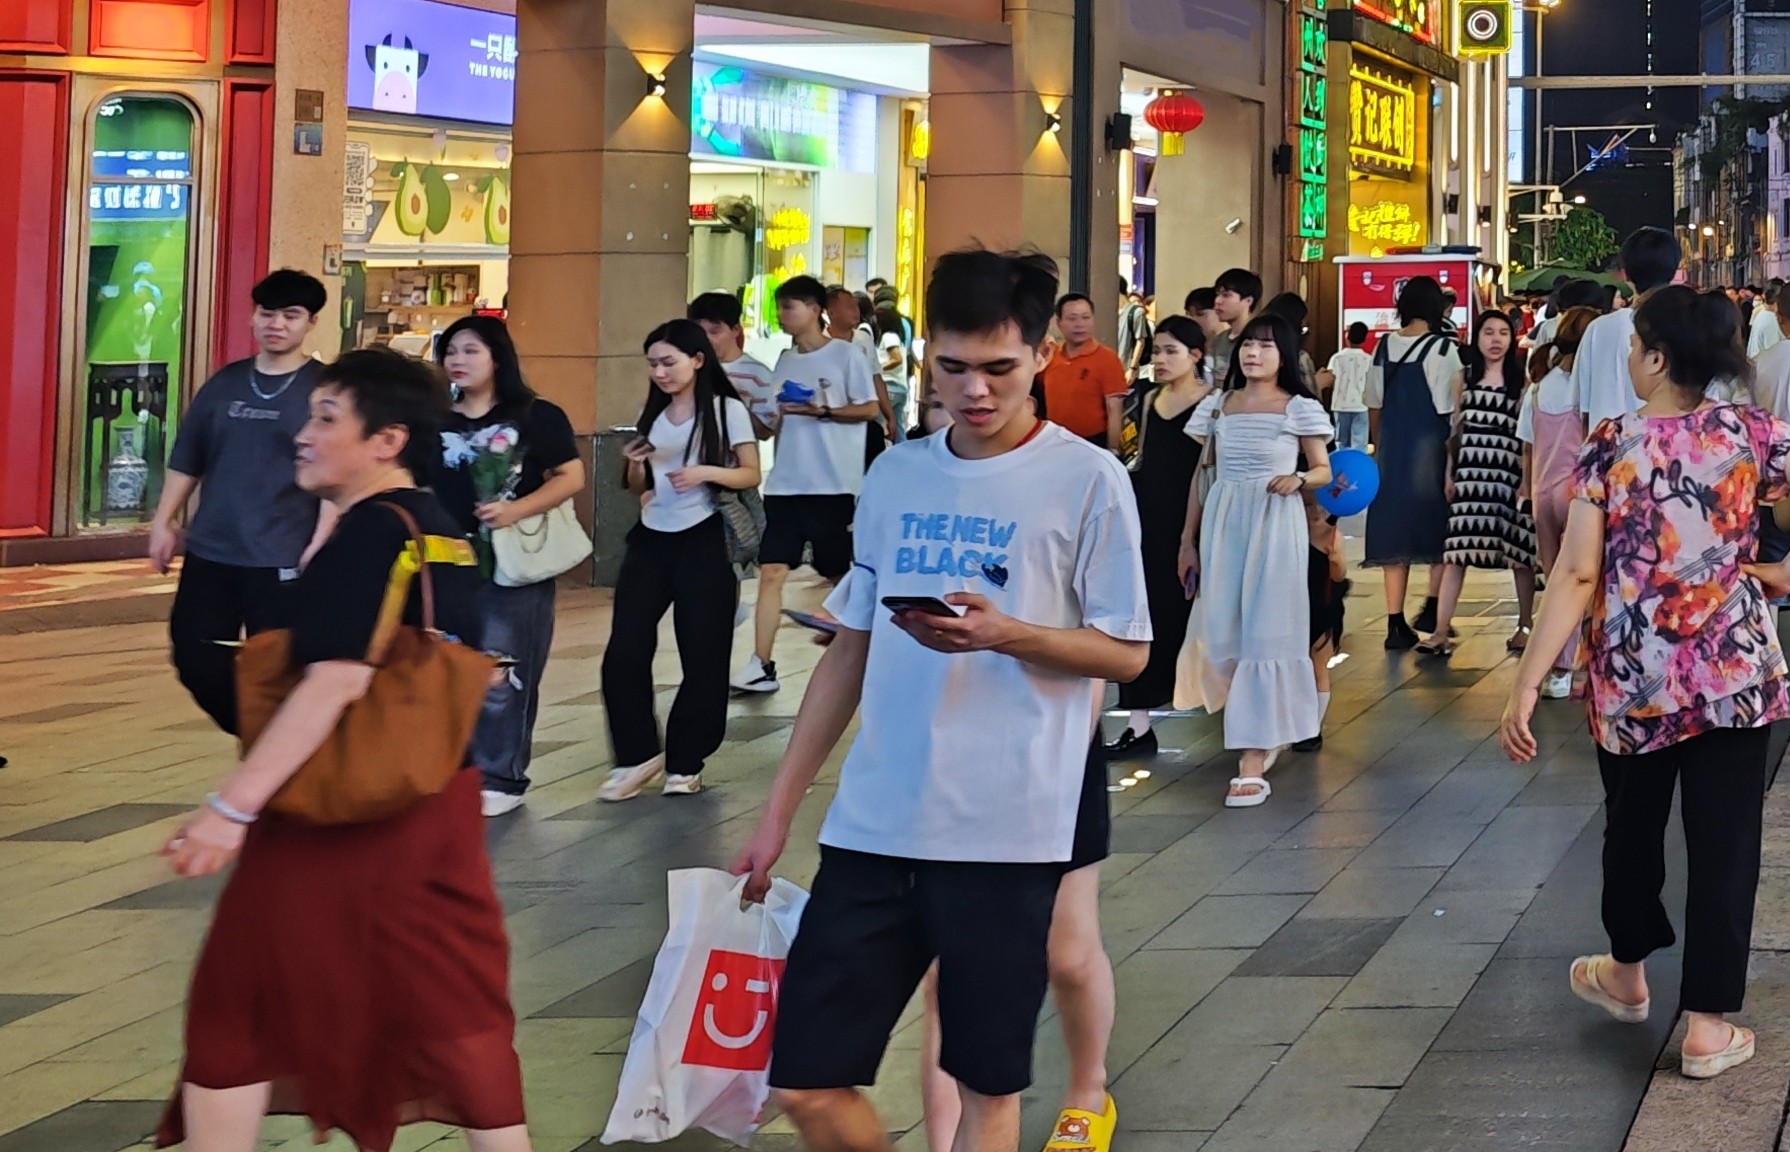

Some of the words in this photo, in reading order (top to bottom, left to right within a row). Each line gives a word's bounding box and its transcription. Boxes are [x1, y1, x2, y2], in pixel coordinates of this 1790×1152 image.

[469, 61, 487, 78] THE
[901, 512, 950, 541] THE
[950, 514, 1018, 549] NEW
